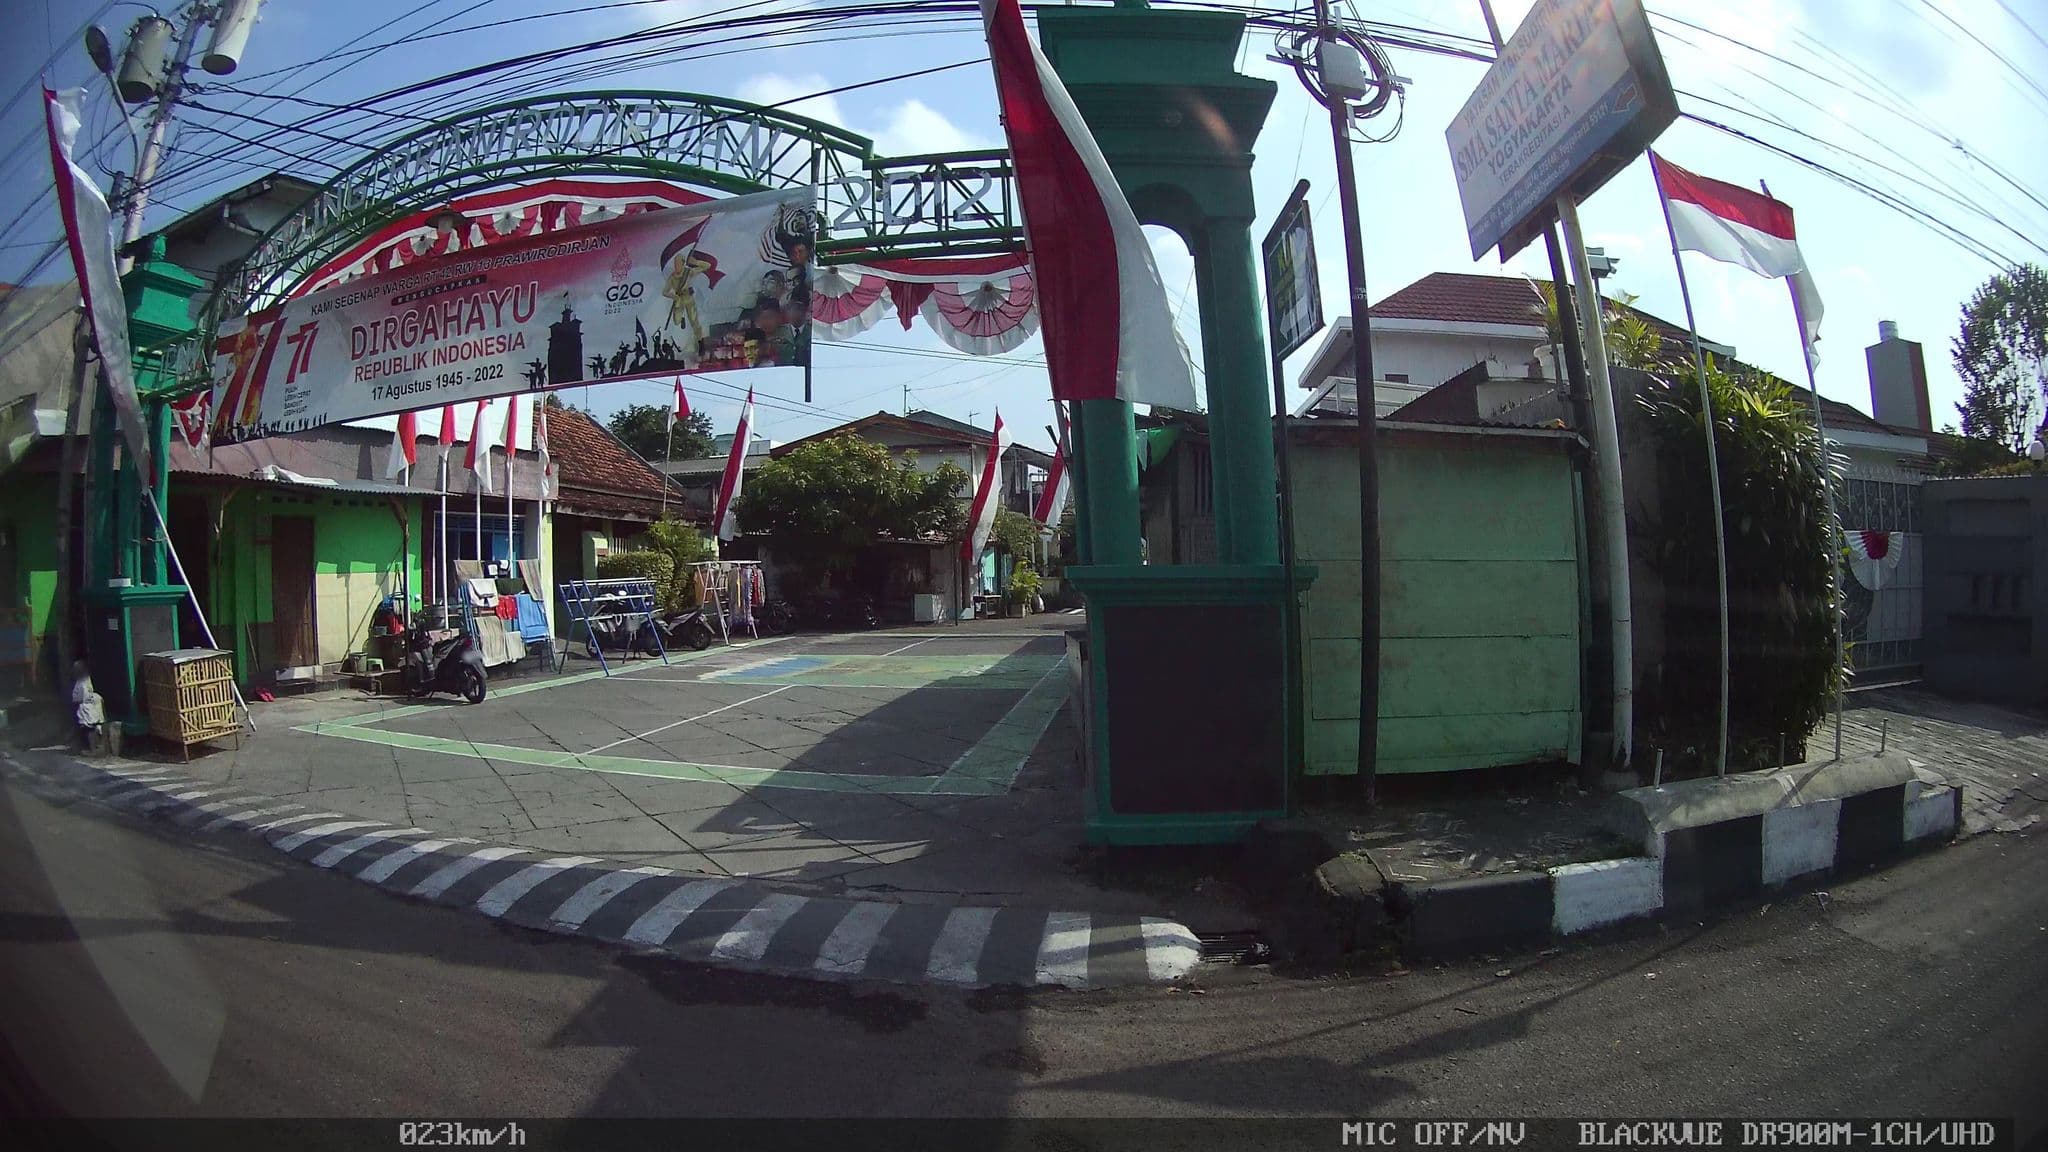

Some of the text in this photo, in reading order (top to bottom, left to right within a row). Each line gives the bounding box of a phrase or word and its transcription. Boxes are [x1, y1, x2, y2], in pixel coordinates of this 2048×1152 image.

[389, 103, 783, 188] PRAWIRODIRJAN
[1456, 127, 1490, 183] SMA
[1484, 72, 1538, 147] SANTA
[1487, 73, 1572, 175] YOGYAKARTA
[1499, 111, 1562, 185] TERAKREDITASI
[833, 165, 993, 231] 2012
[311, 302, 333, 316] KAMI
[334, 286, 380, 309] SEGENAP
[381, 275, 421, 295] WARGA
[422, 270, 439, 284] RT
[454, 260, 476, 276] RW
[494, 235, 611, 269] PRAWIRODIRJAN
[606, 281, 644, 302] G20
[286, 320, 320, 384] 77
[350, 280, 539, 362] DIRGAHAYU
[354, 331, 526, 384] REPUBLIK INDONESIA
[371, 386, 384, 401] 17
[384, 378, 432, 401] Agustus
[435, 370, 464, 389] 1945
[473, 363, 504, 382] 2022
